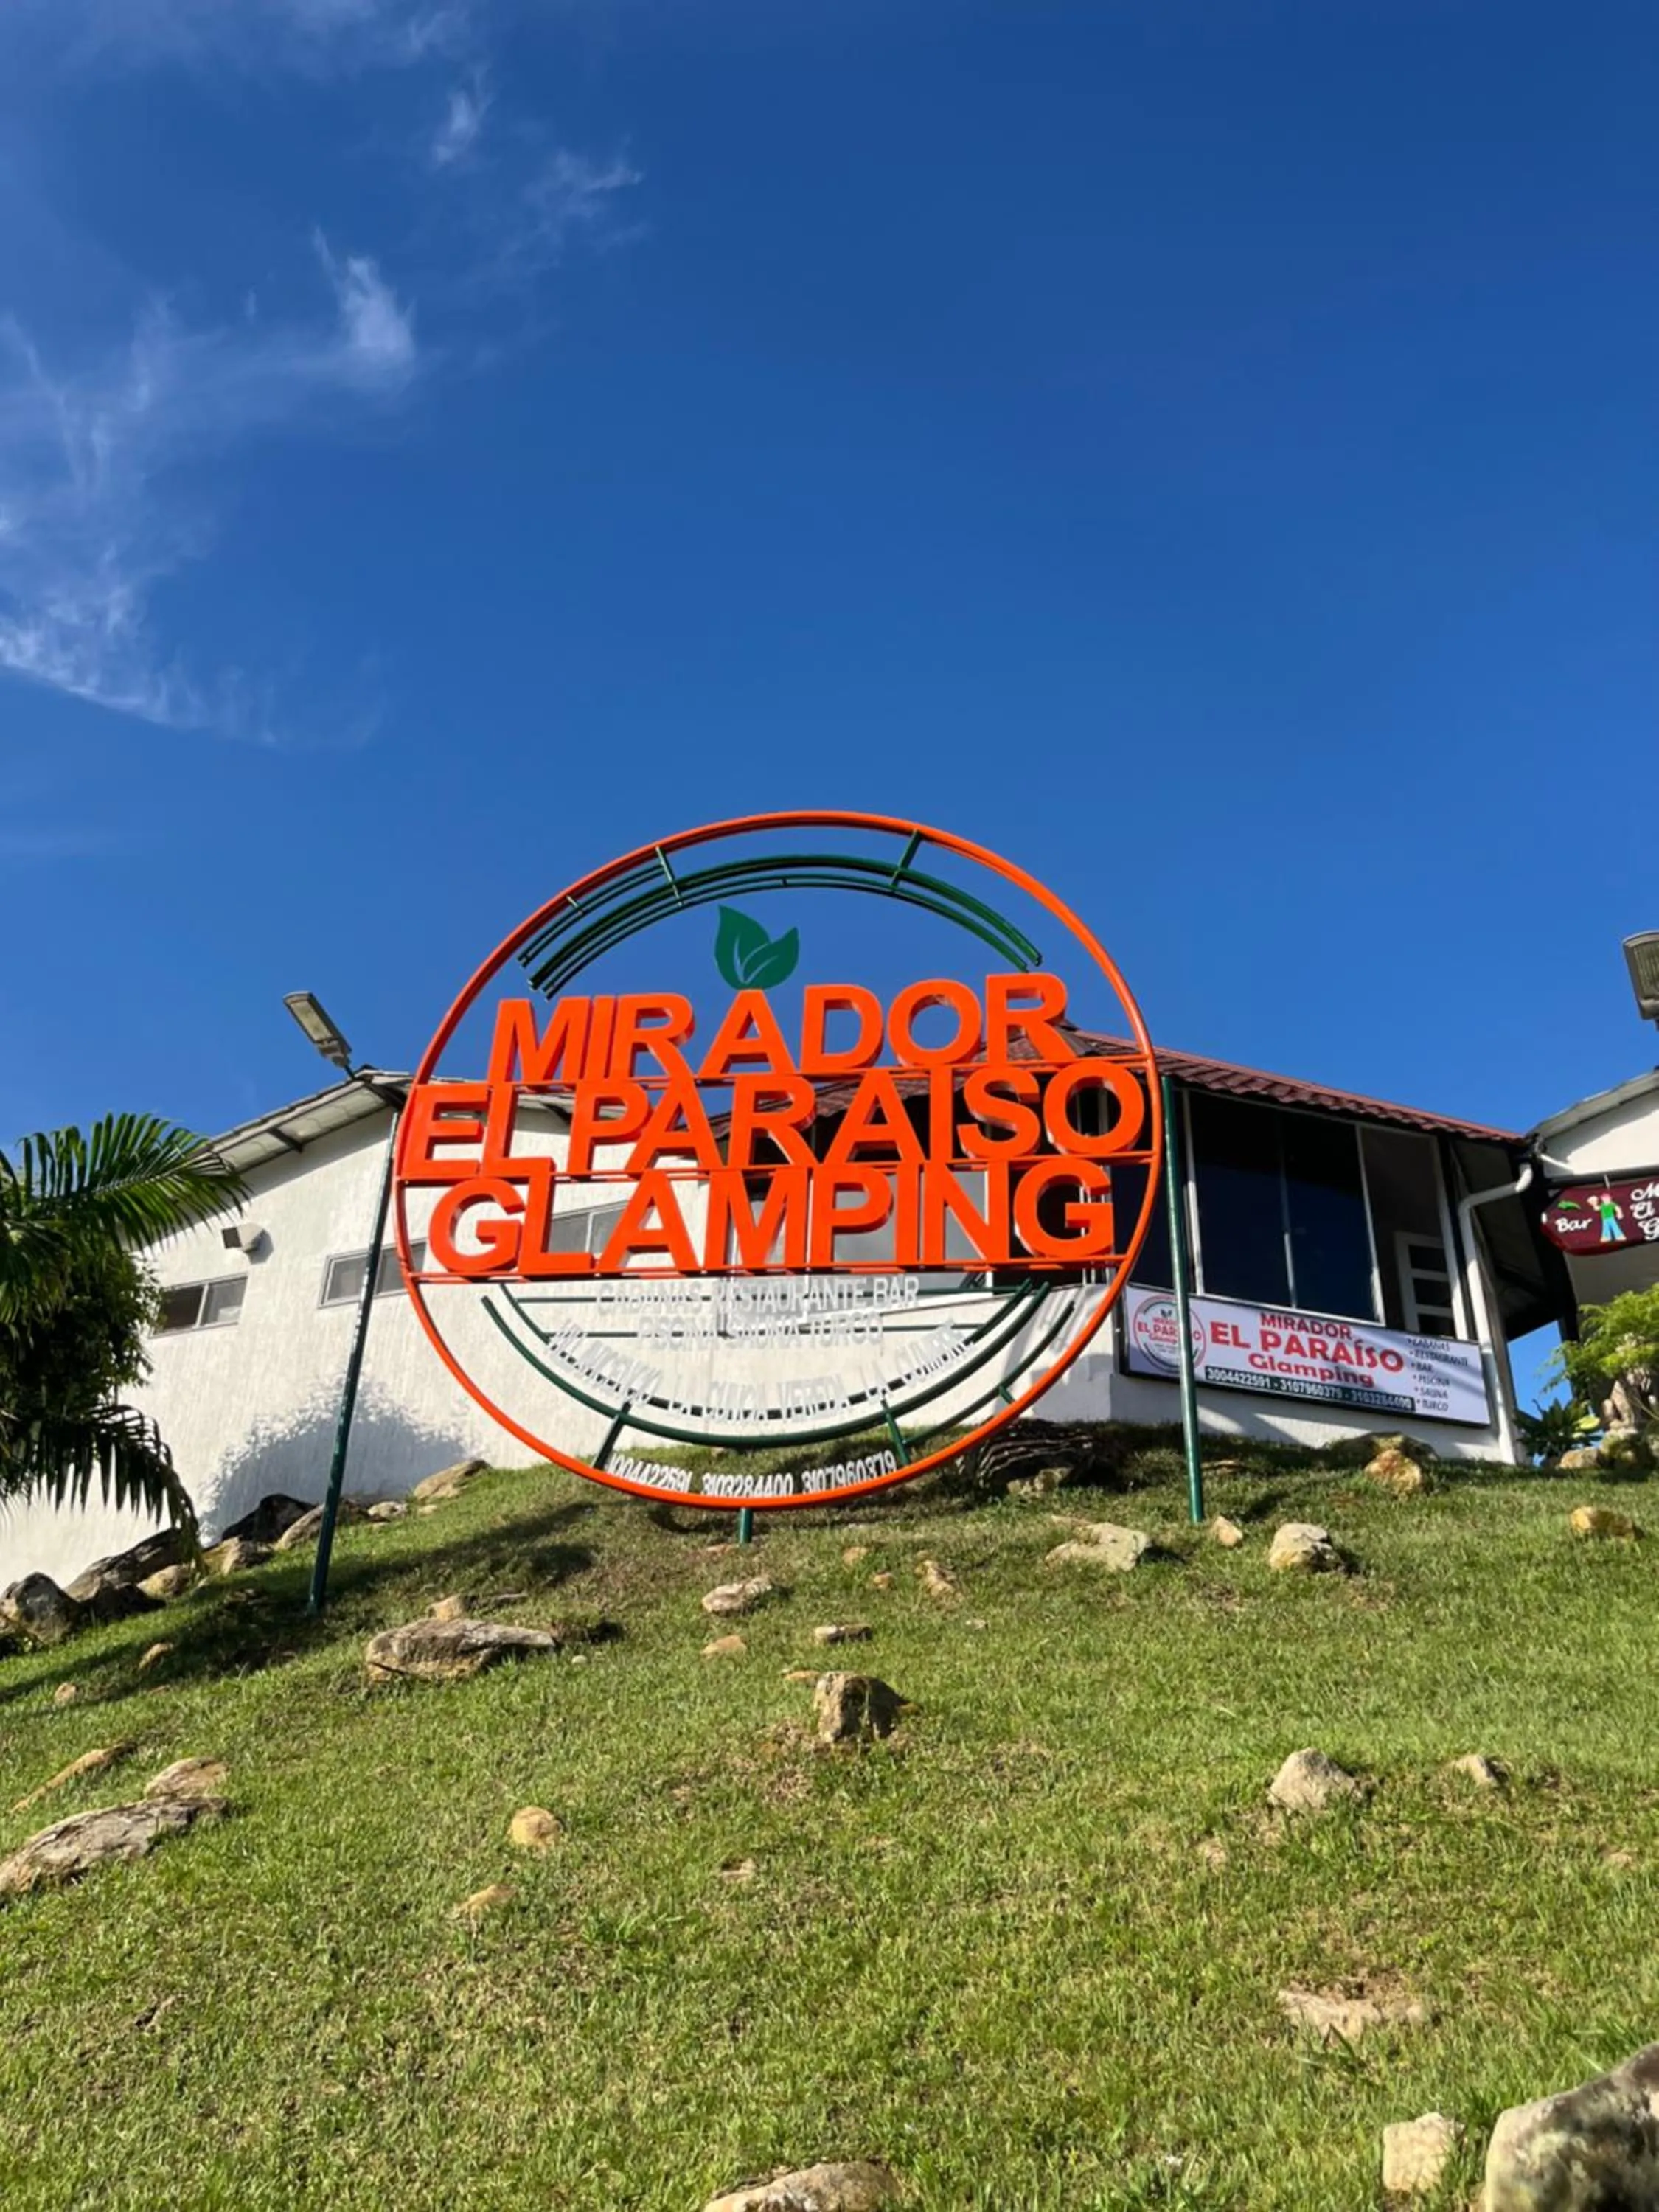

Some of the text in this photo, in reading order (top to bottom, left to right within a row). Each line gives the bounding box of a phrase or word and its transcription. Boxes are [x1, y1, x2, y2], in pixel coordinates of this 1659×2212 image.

[487, 971, 1077, 1084] MIRADOR
[400, 1058, 1145, 1178] EL PARAISO
[428, 1156, 1116, 1274] GLAMPING
[1555, 1217, 1593, 1233] Bar
[873, 1276, 920, 1307] BAR
[1210, 1321, 1251, 1349] EL
[1260, 1312, 1352, 1340] MIRADOR
[1248, 1352, 1374, 1388] Glamping
